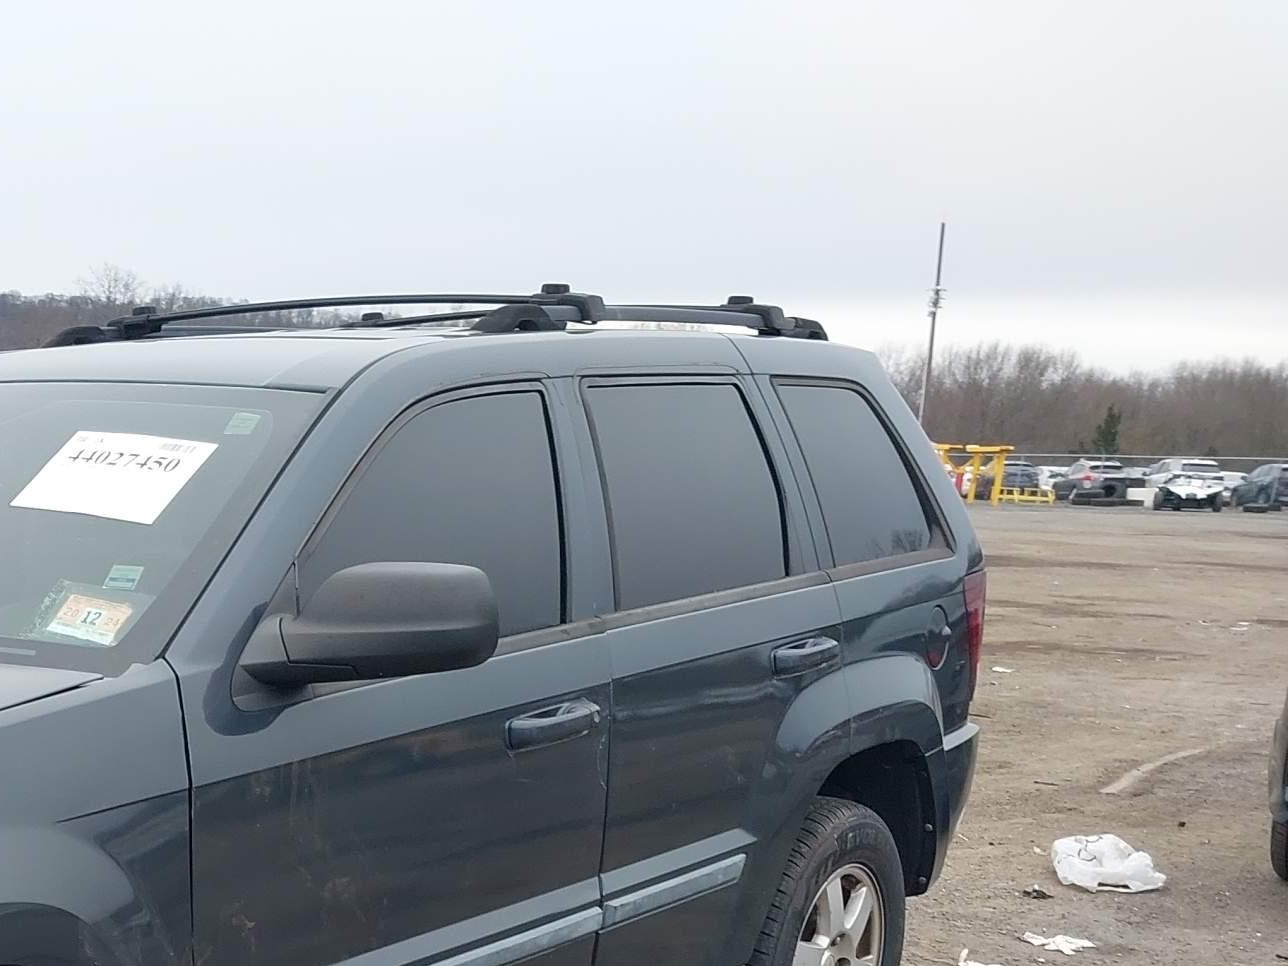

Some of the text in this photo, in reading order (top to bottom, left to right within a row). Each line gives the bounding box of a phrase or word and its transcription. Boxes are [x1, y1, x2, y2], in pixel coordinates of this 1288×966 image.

[68, 449, 181, 472] 44027450
[63, 607, 80, 618] 20
[80, 610, 102, 626] 12
